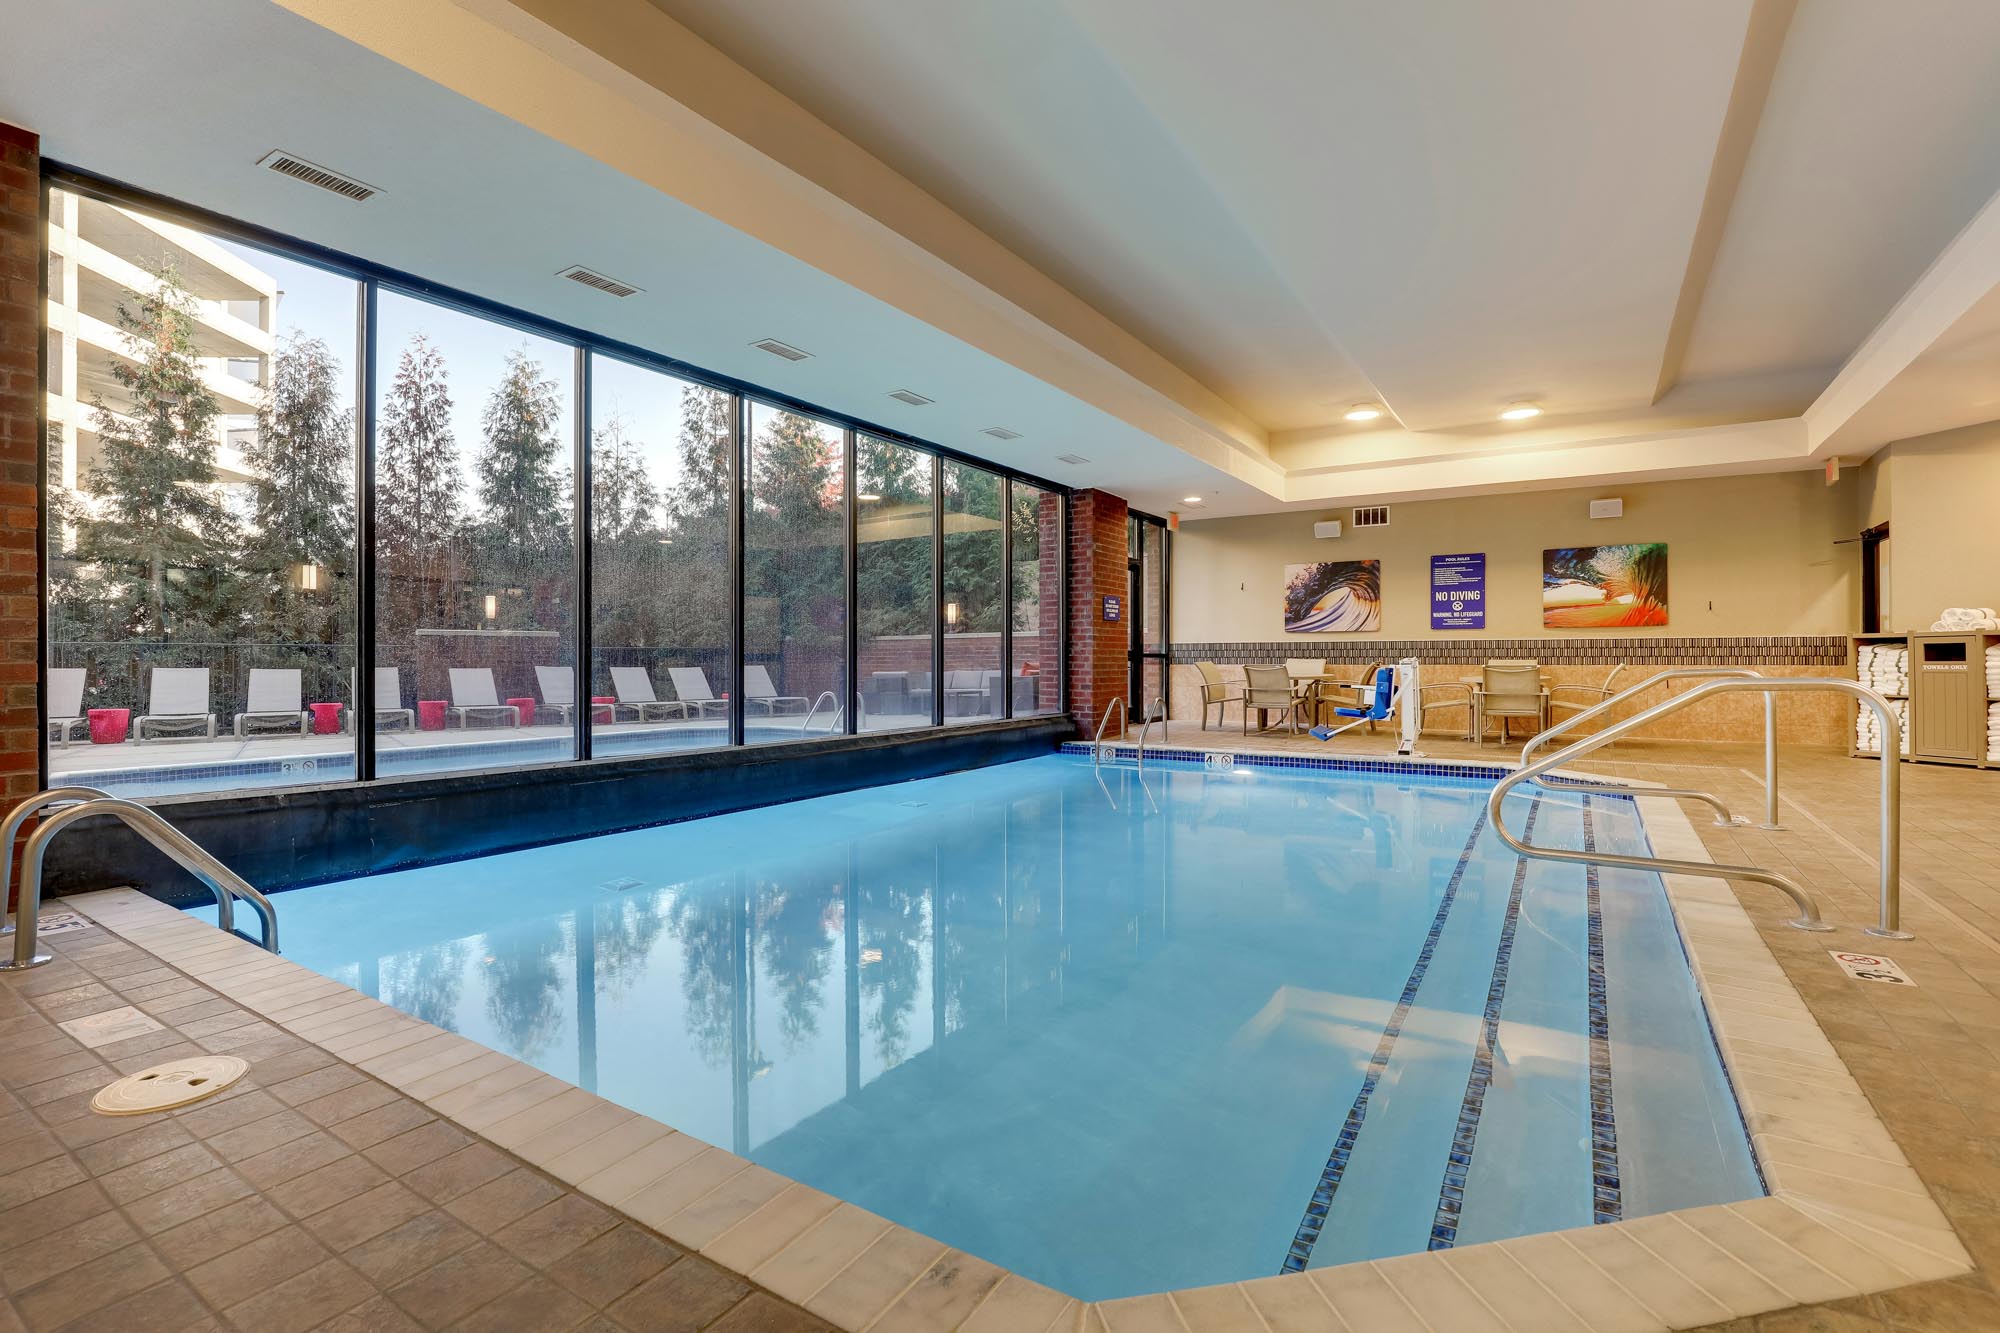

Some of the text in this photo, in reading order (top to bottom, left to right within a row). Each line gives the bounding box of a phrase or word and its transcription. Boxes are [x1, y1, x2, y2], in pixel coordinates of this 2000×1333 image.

[1436, 591, 1480, 601] NO DIVING
[1855, 971, 1905, 984] 3
